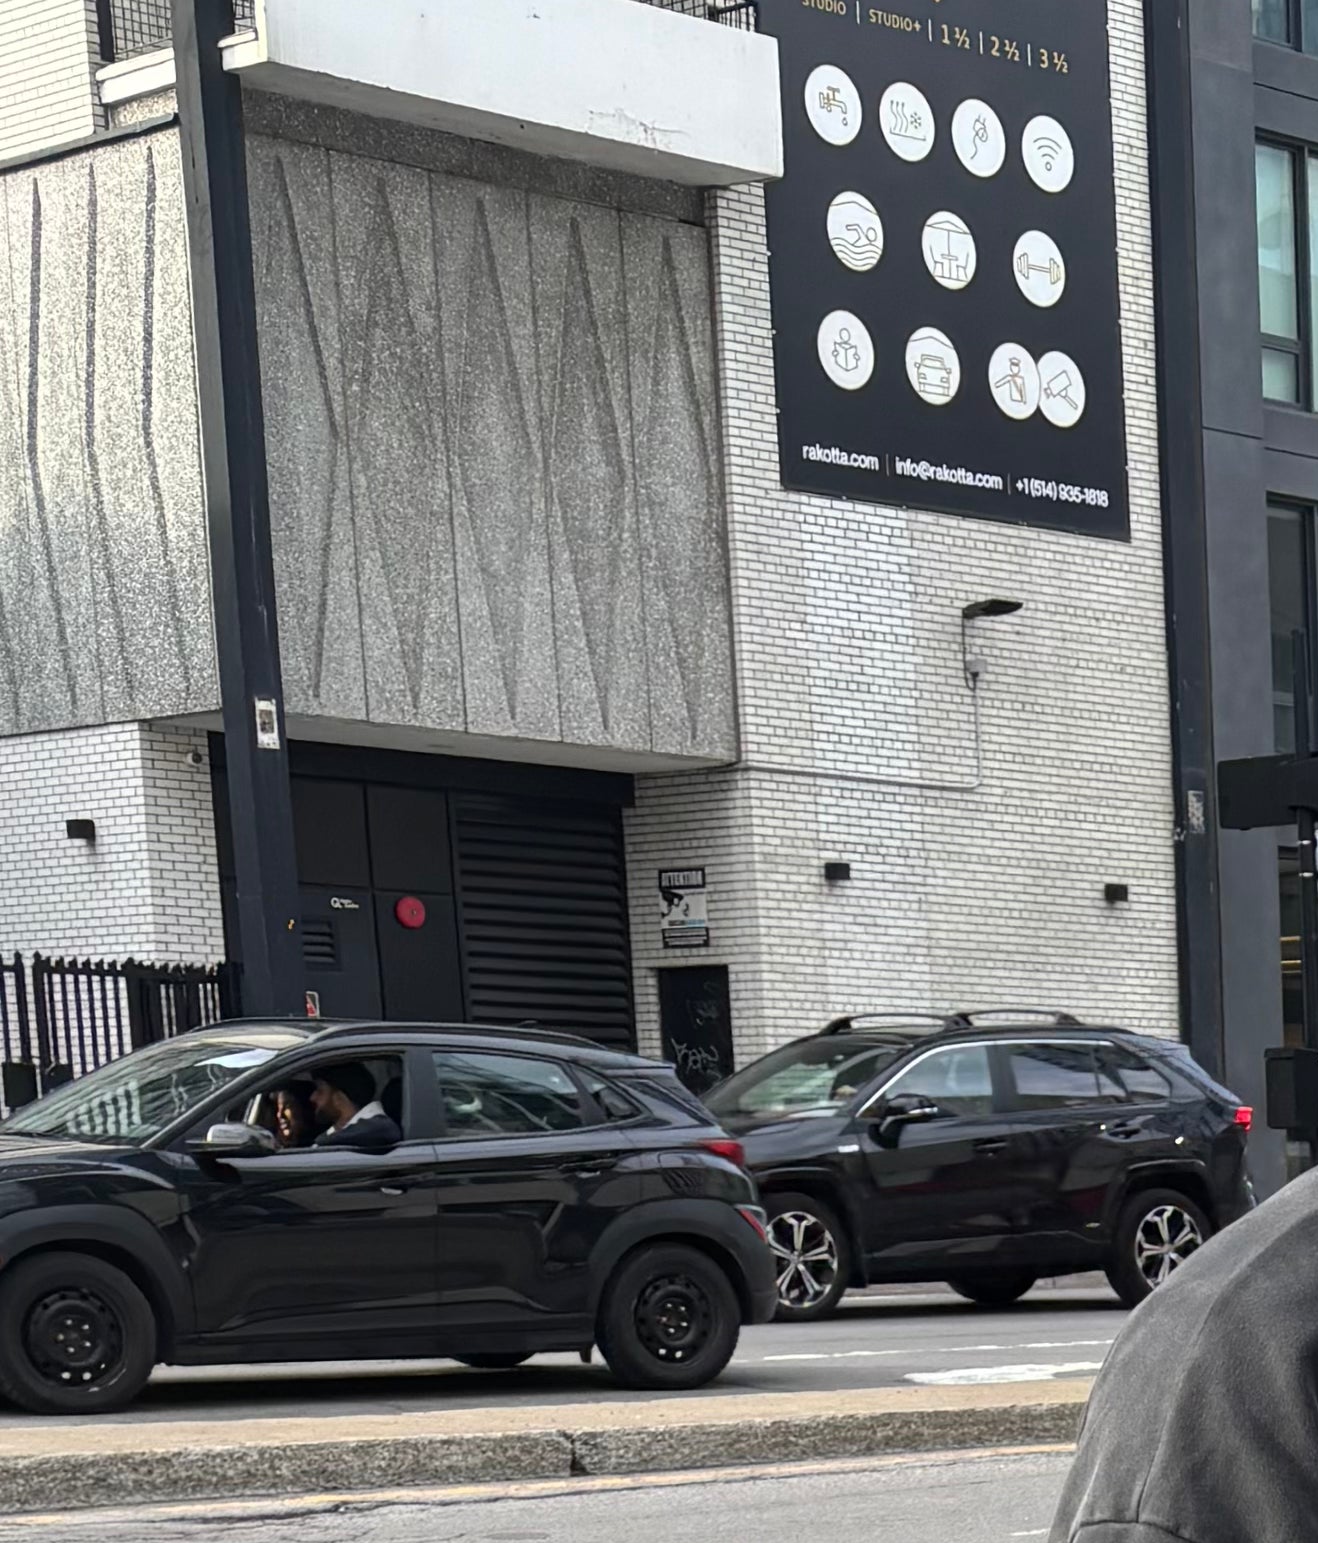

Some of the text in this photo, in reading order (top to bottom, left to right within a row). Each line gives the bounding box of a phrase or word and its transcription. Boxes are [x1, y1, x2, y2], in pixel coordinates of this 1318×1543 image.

[868, 9, 922, 32] STUDIO+
[802, 444, 879, 472] rakotta.com
[895, 456, 1003, 491] info@rakotta.com
